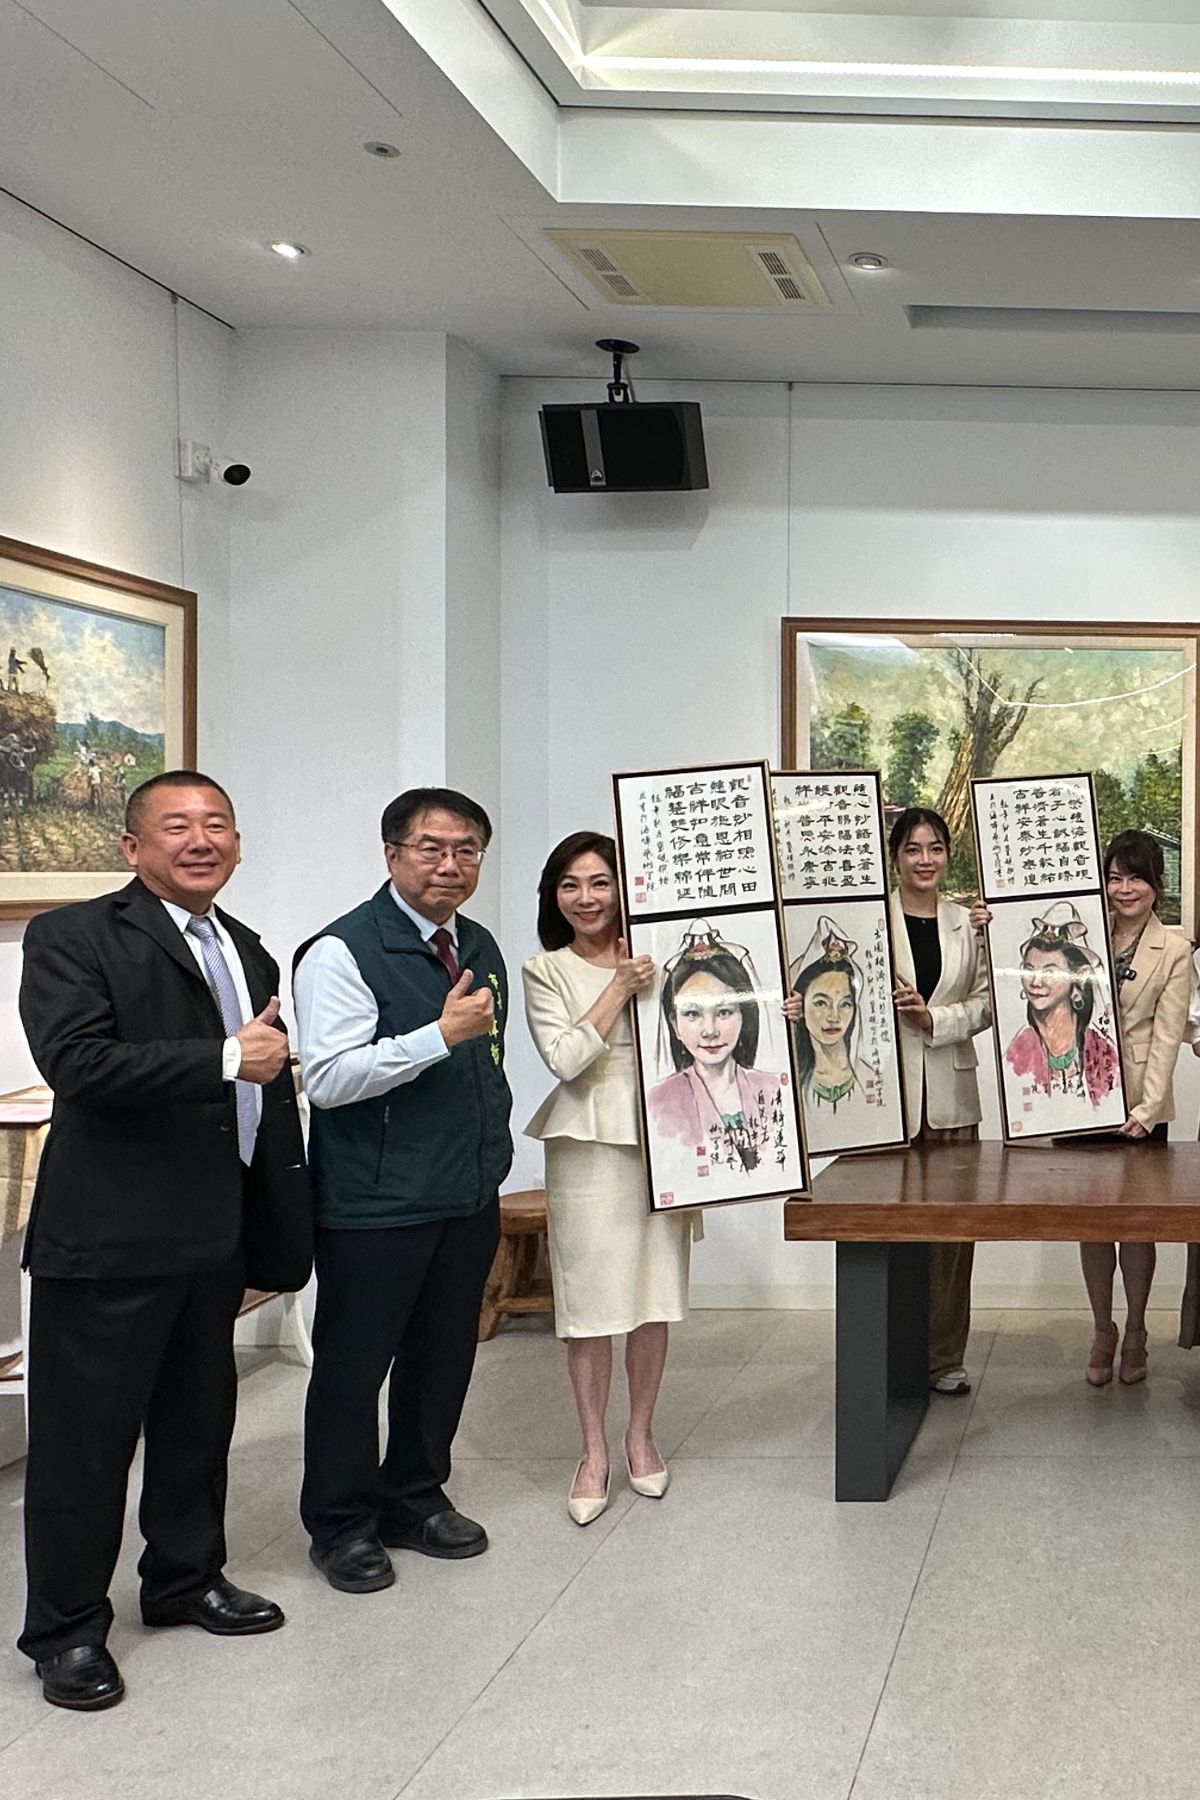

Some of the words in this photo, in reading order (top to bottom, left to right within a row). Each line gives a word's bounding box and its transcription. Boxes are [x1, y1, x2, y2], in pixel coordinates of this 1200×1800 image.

[795, 785, 820, 889] 祥普照永康寧
[815, 785, 838, 887] 護平安添吉兆
